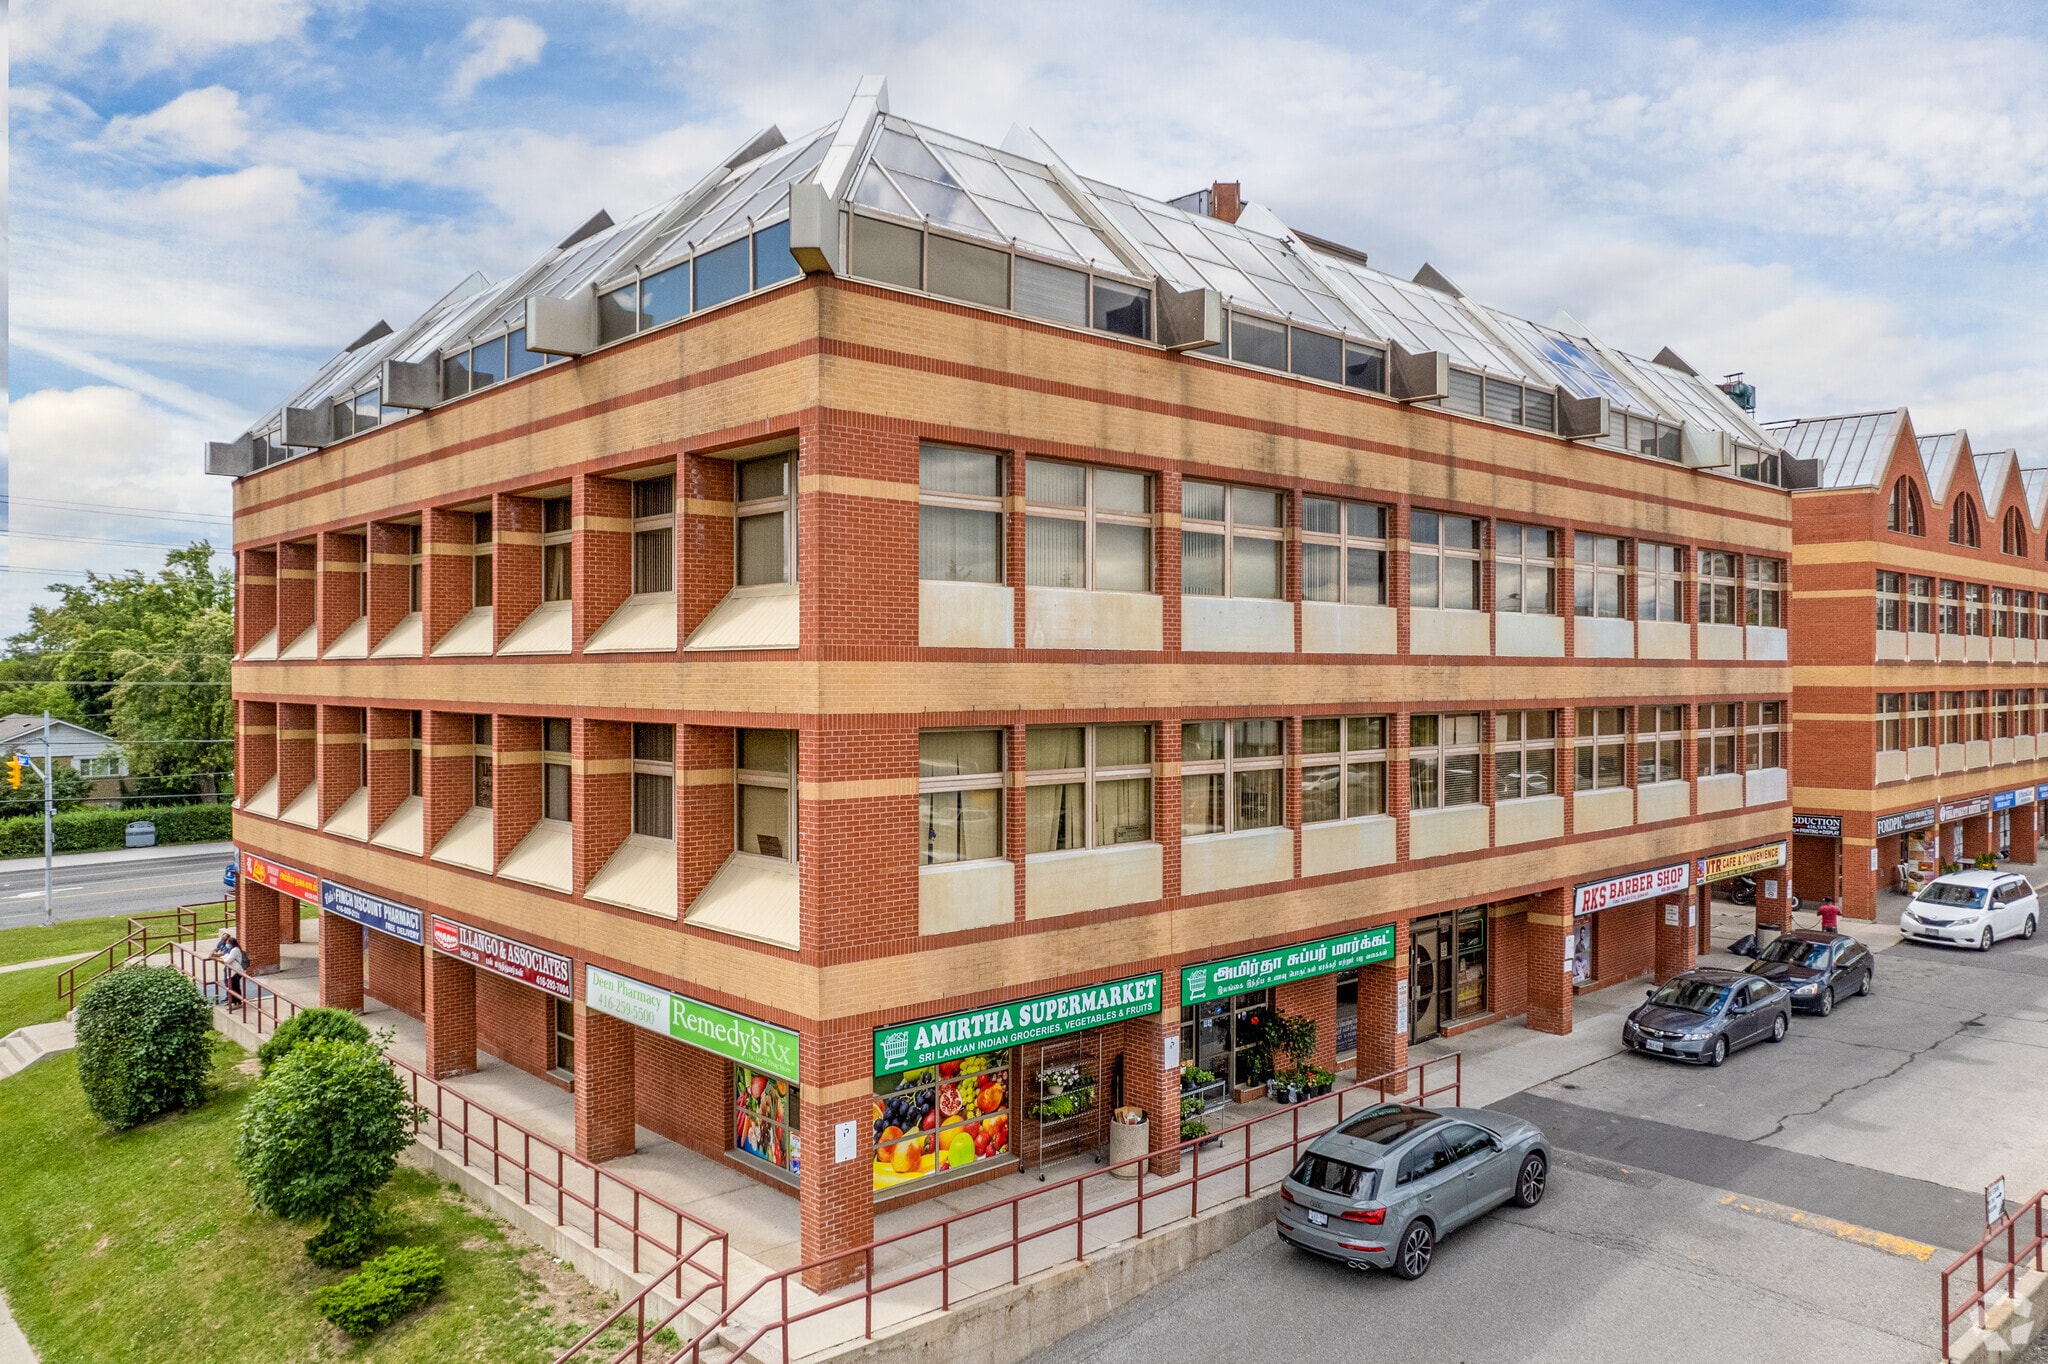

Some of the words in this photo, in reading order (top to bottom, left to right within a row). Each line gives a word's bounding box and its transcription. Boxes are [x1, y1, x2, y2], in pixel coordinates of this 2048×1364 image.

[1706, 859, 1722, 874] VTR
[1722, 857, 1736, 868] CAFE
[1742, 848, 1778, 864] CONVENIENCE
[336, 888, 354, 908] FINCH
[354, 894, 382, 918] DISCOUNT
[384, 904, 418, 930] PHARMACY
[1582, 886, 1606, 912] RKS
[1609, 874, 1653, 899] BARBER
[1657, 867, 1683, 887] SHOP
[385, 922, 396, 932] FREE
[397, 926, 420, 940] DELIVERY
[460, 928, 498, 956] ILLANGO
[500, 942, 506, 960] &
[508, 945, 568, 981] ASSOCIATES
[1214, 957, 1282, 982] அமிர்தா
[1287, 944, 1327, 966] சுப்பர்
[1332, 930, 1390, 956] மார்க்கட்
[592, 972, 614, 991] Deen
[616, 980, 662, 1012] Pharmacy
[598, 993, 654, 1025] 416-259-5500
[914, 1008, 1014, 1050] AMIRTHA
[1019, 979, 1157, 1027] SUPERMARKET
[918, 1051, 935, 1064] SRI
[937, 1042, 976, 1060] LANKAN
[977, 1035, 1008, 1049] INDIAN
[1010, 1023, 1062, 1043] GROCERIES,
[1064, 1012, 1116, 1029] VEGETABLES
[1118, 1009, 1124, 1018] &
[1126, 1002, 1153, 1016] FRUITS
